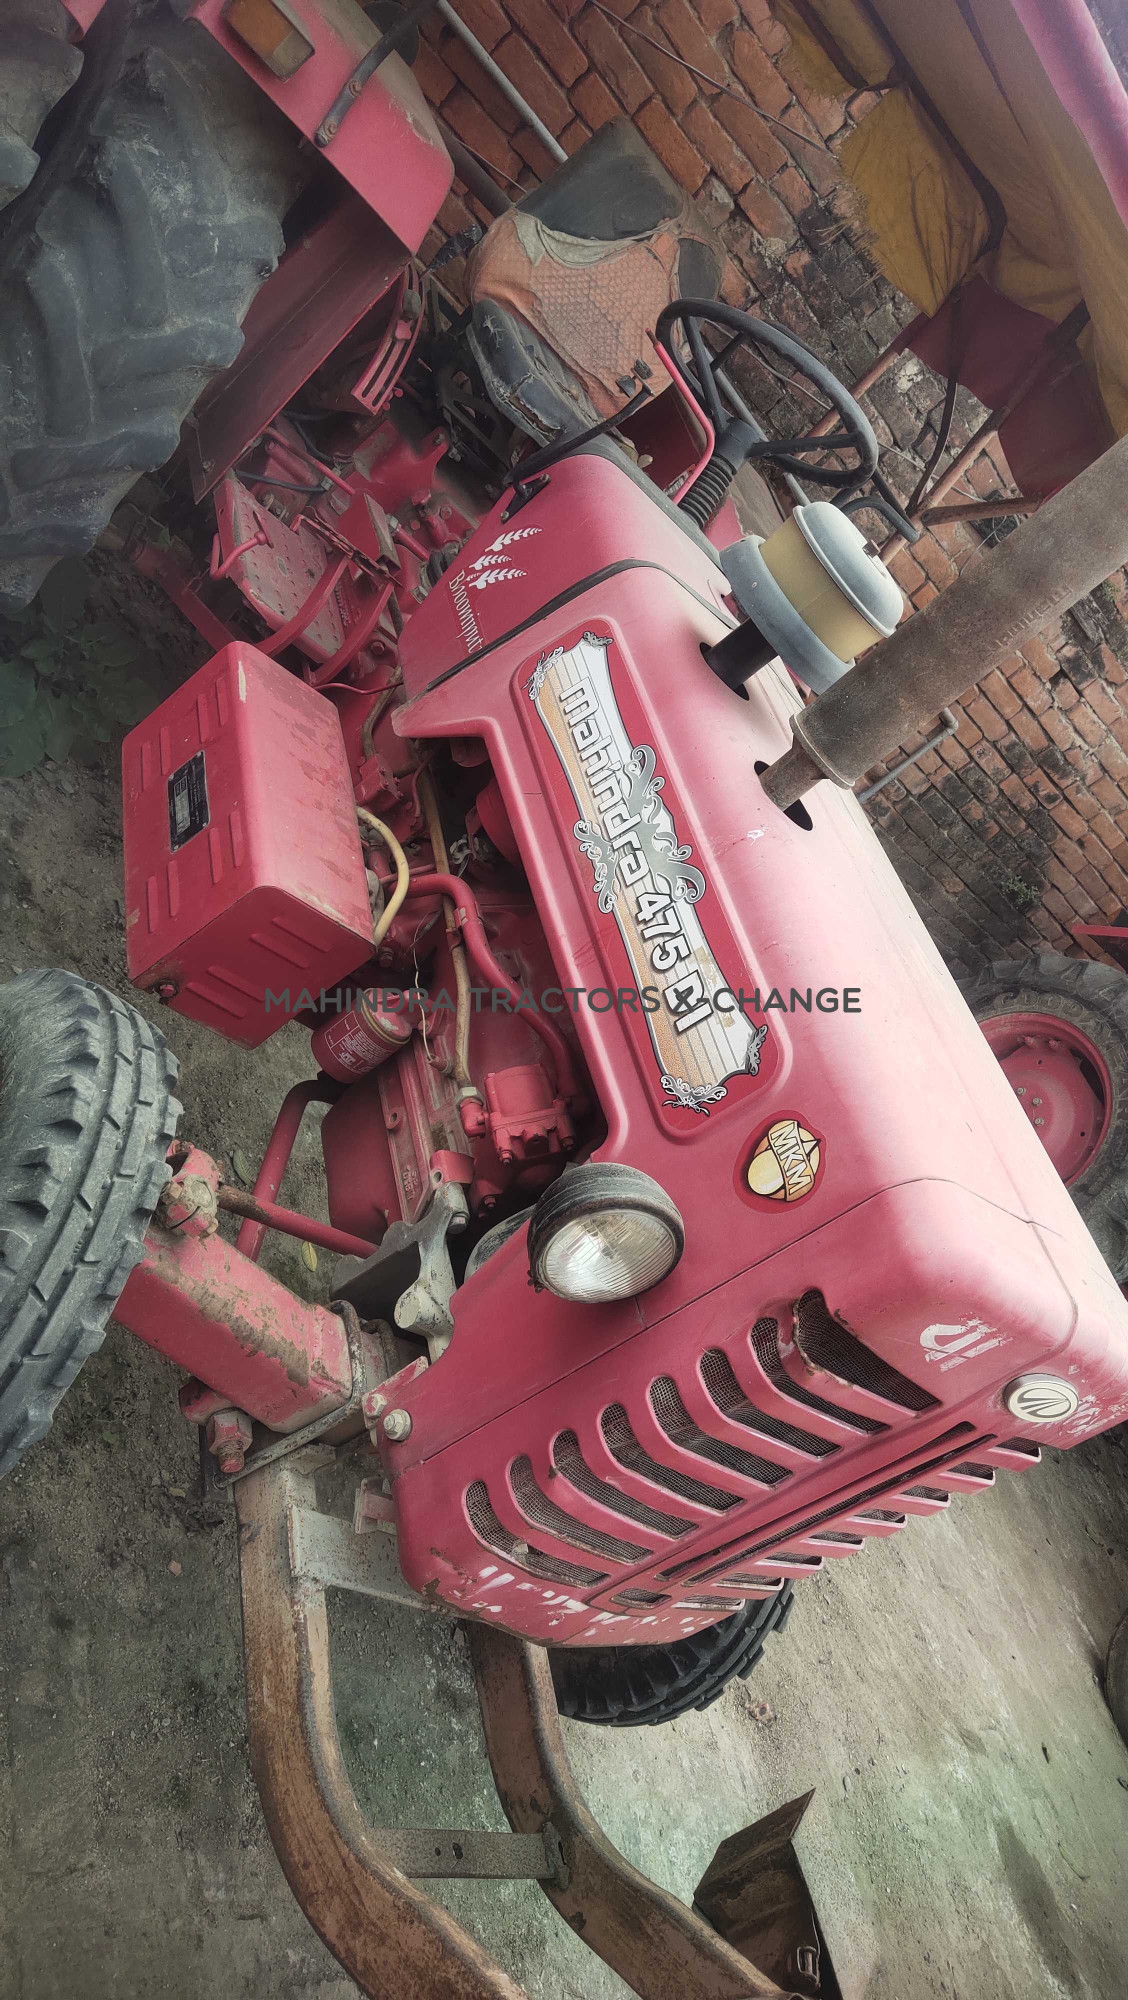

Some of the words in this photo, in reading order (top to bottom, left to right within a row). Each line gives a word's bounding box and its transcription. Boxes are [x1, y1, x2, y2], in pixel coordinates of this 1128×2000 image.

[636, 891, 692, 972] 475
[663, 969, 714, 1034] DI
[770, 1121, 813, 1196] MKM
